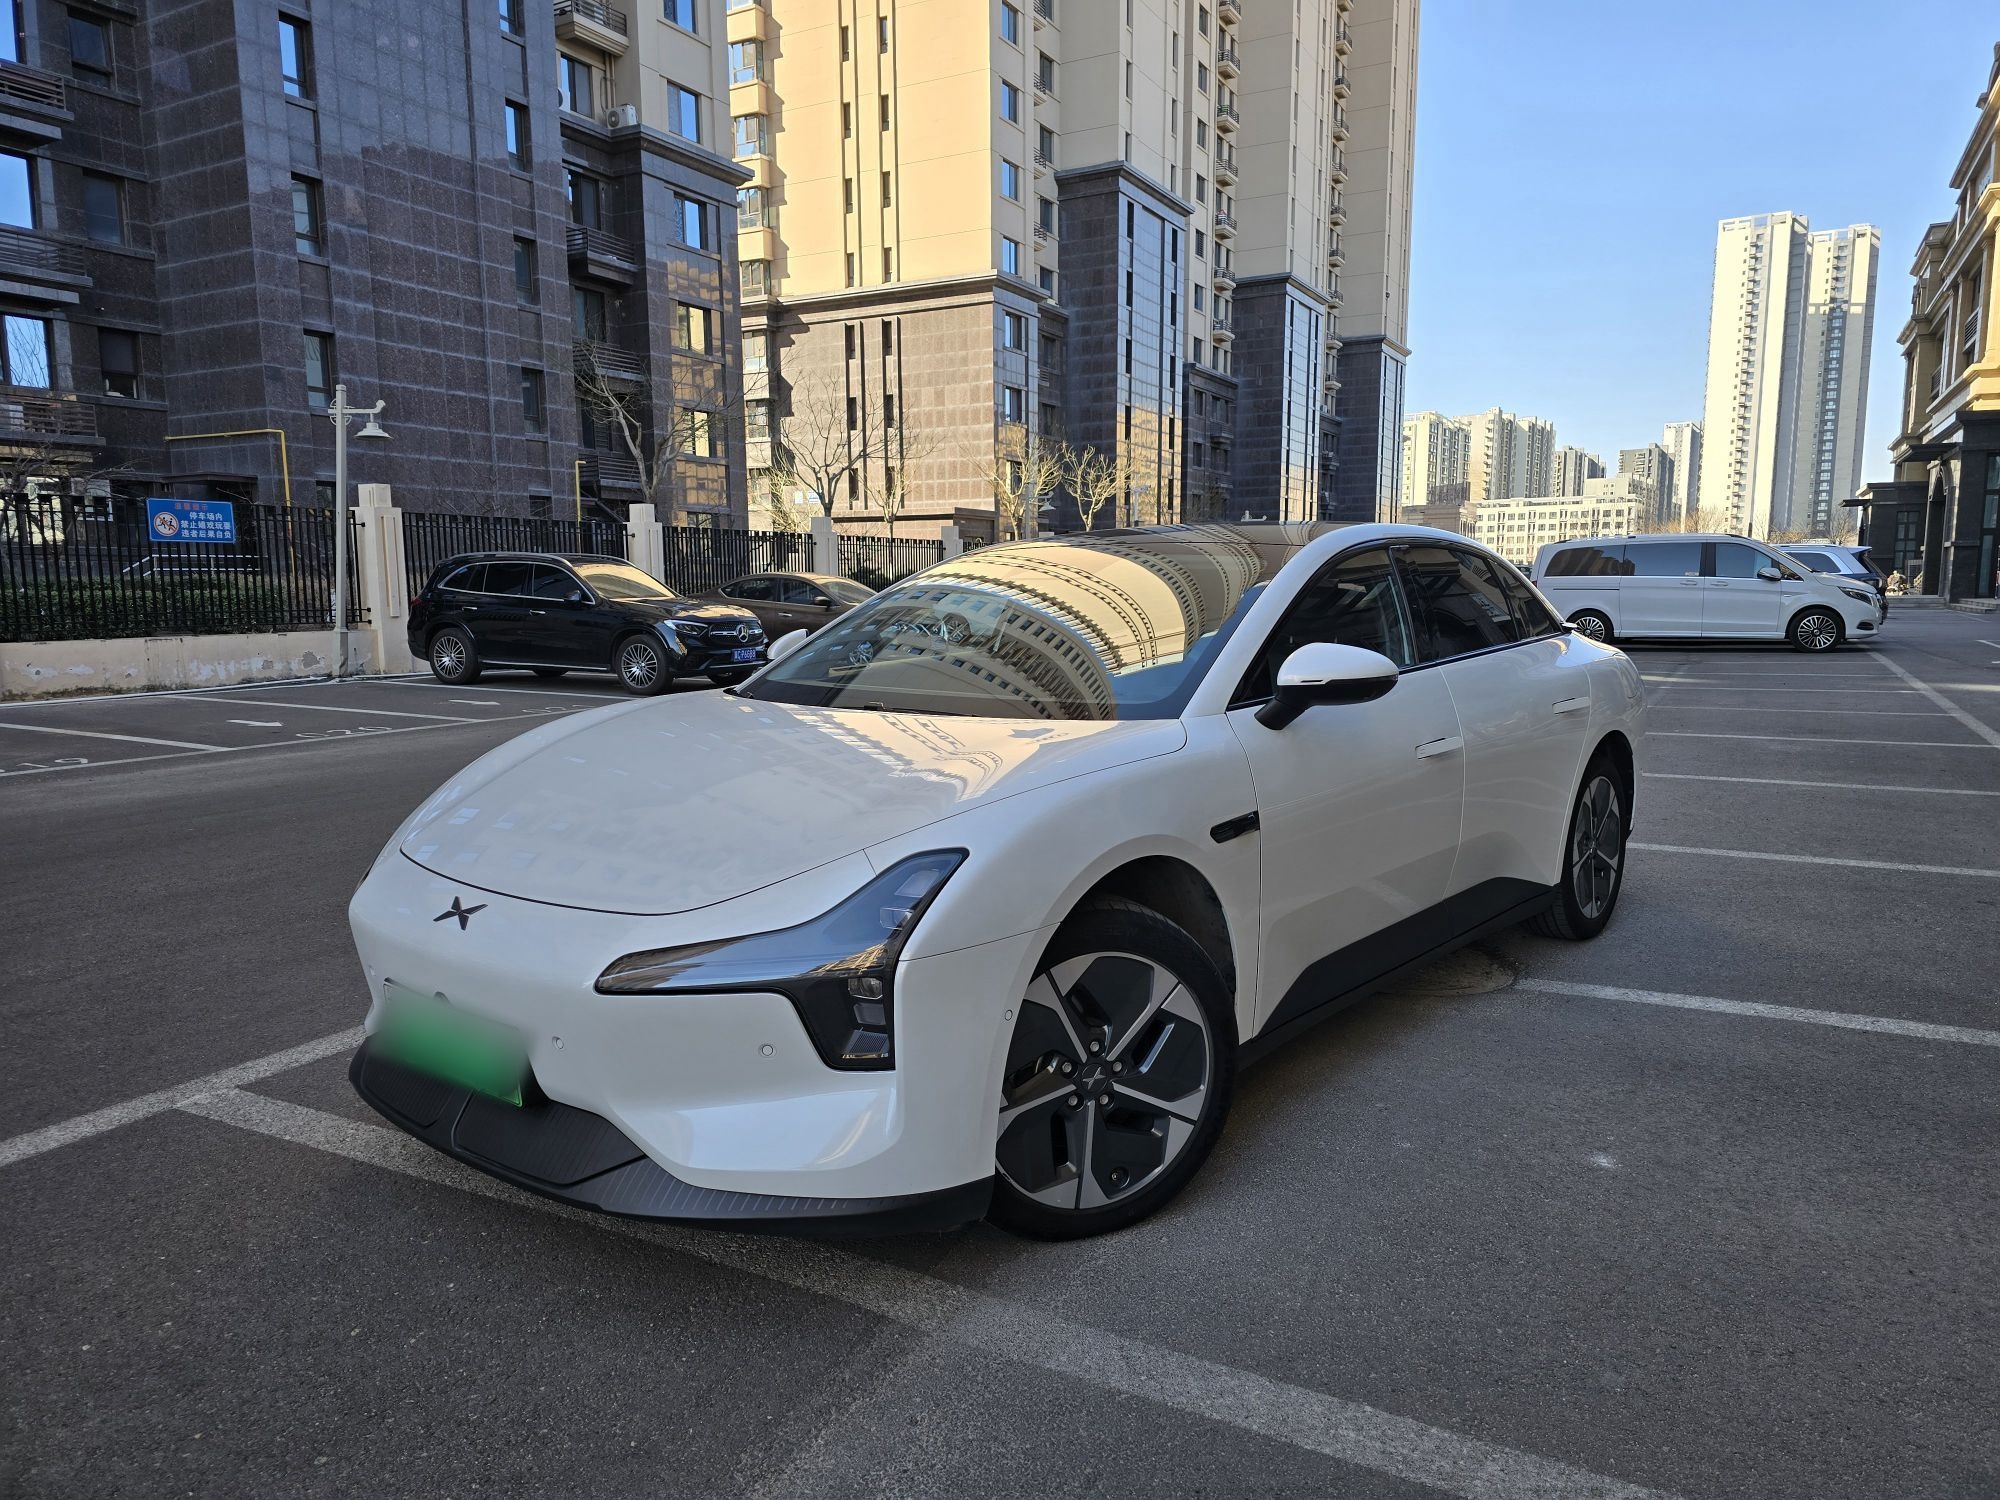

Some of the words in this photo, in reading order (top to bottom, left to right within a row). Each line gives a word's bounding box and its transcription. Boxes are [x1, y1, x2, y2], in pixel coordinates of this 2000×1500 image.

[189, 511, 223, 521] 停车场内
[181, 529, 232, 539] 违者后果自负
